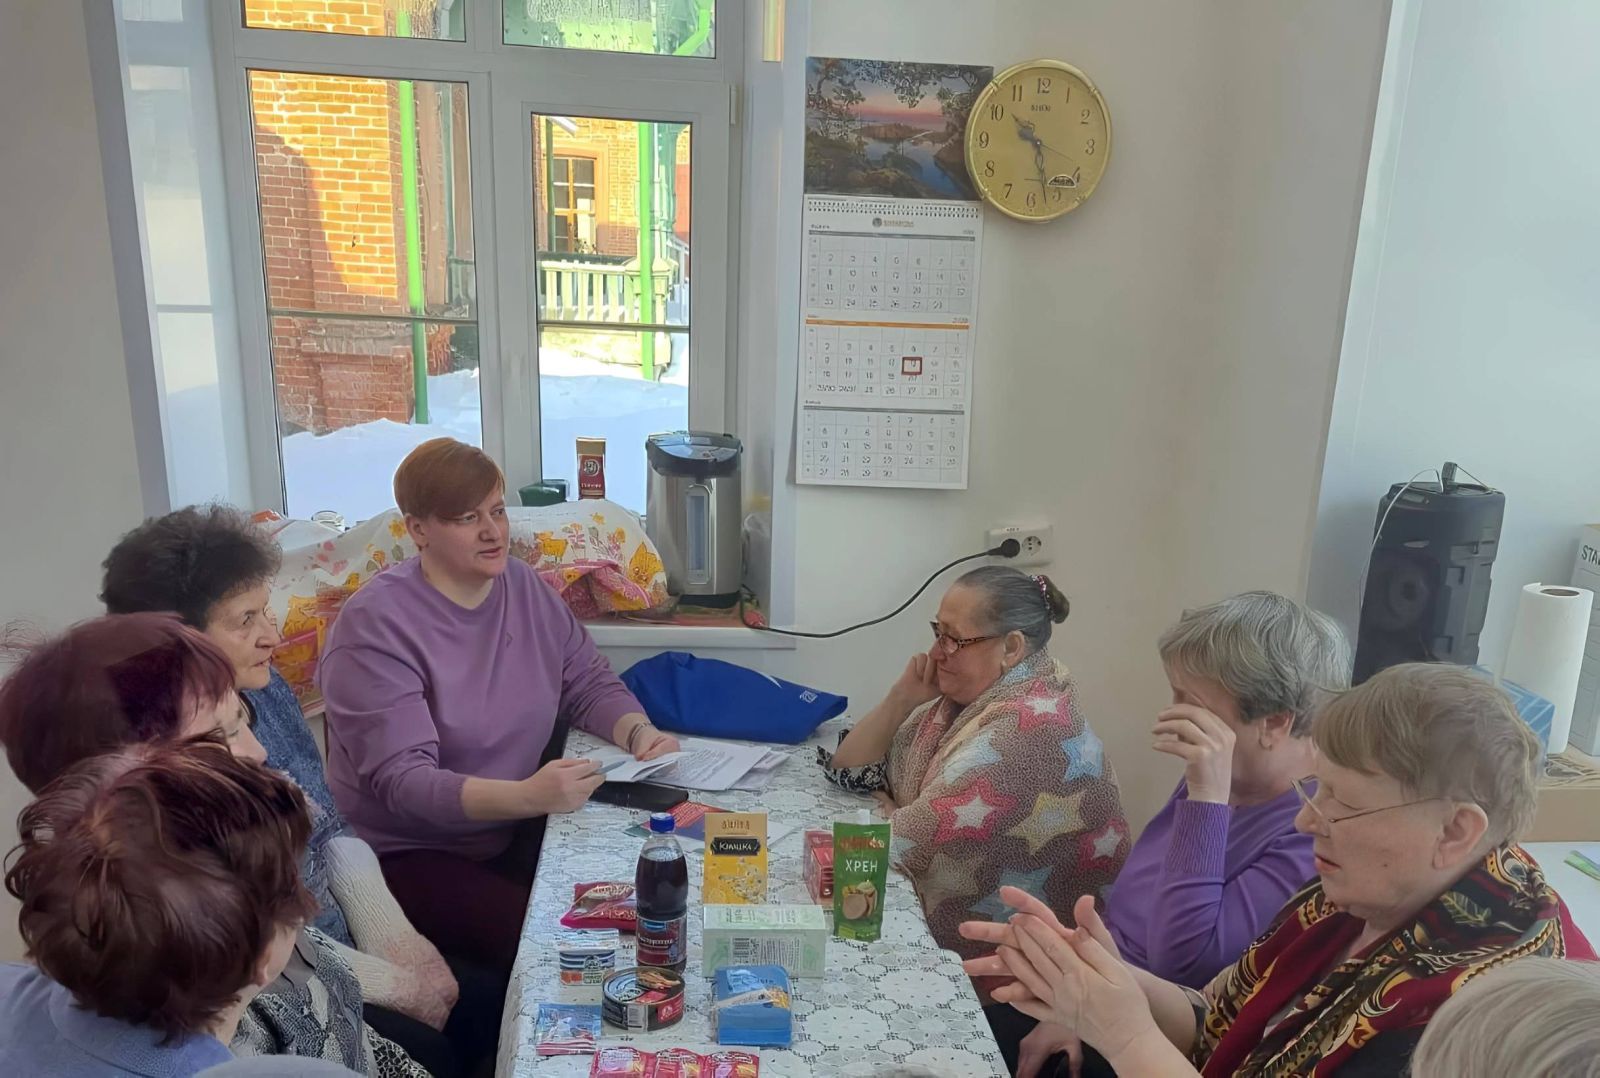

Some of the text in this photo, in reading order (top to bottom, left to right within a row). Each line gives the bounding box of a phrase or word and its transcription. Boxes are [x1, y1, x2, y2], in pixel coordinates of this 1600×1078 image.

[1012, 84, 1023, 102] 11
[1037, 78, 1051, 94] 12
[990, 104, 1004, 121] 10
[1080, 109, 1091, 125] 2
[978, 131, 990, 149] 9
[1085, 139, 1096, 156] 3
[984, 160, 996, 178] 8
[1072, 166, 1081, 184] 4
[1003, 183, 1013, 199] 7
[1026, 191, 1036, 209] 6
[1581, 544, 1600, 566] STA
[845, 859, 878, 873] ХРЕН
